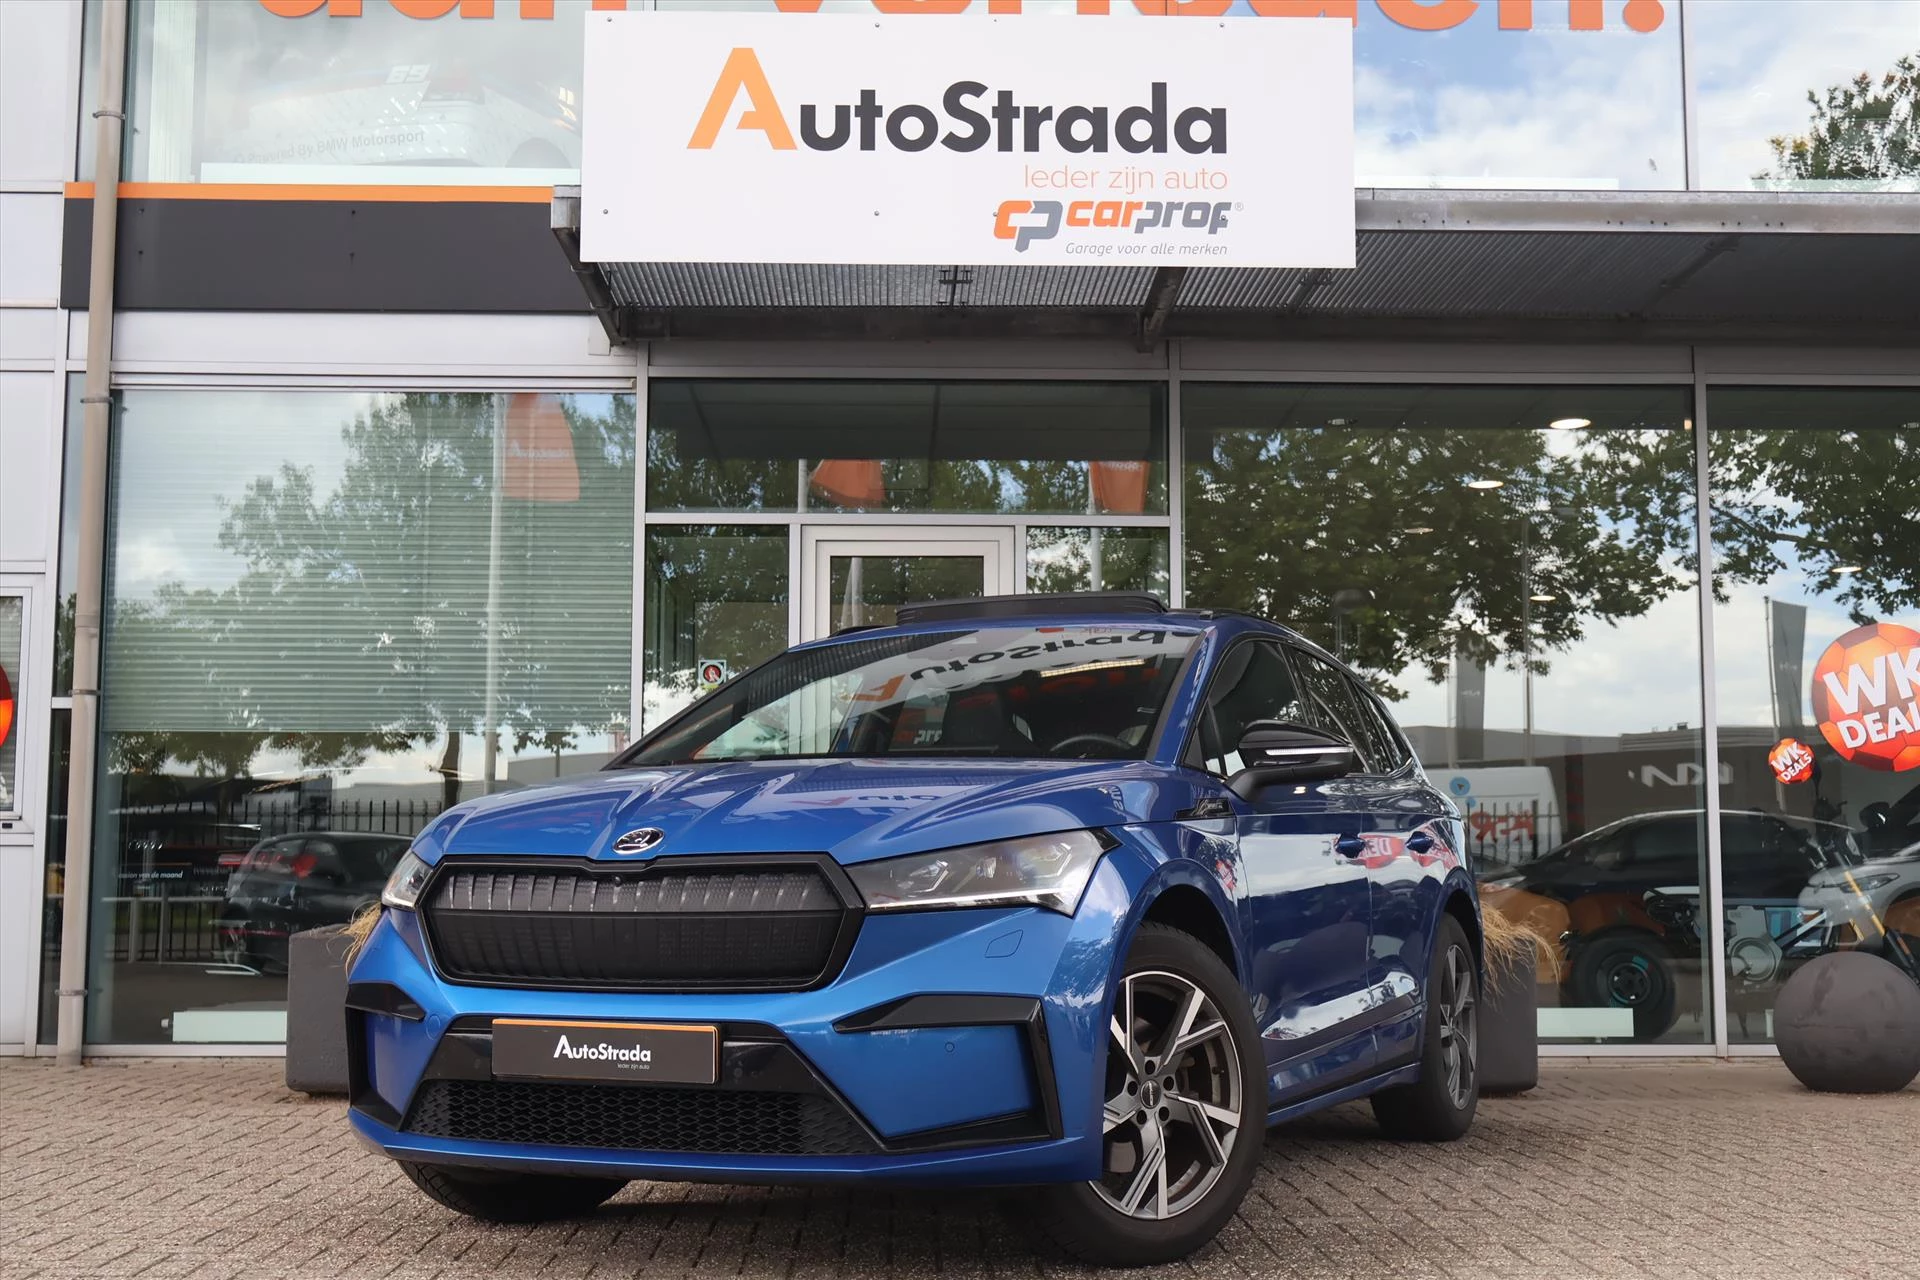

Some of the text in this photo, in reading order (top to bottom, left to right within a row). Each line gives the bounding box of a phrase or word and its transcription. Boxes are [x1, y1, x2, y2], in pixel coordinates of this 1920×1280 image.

[386, 64, 431, 84] 69
[686, 47, 1228, 154] AutoStrada
[298, 143, 315, 156] By
[317, 138, 349, 154] BMW
[352, 131, 425, 147] Motorsport
[1025, 165, 1228, 195] Ieder zijn auto
[1065, 242, 1228, 257] Garage voor alle merken
[1822, 647, 1920, 715] WK
[1771, 741, 1806, 772] WK
[1780, 754, 1812, 781] DEALS
[151, 871, 159, 879] de
[160, 870, 183, 879] maand
[553, 1034, 651, 1063] AutoStrada
